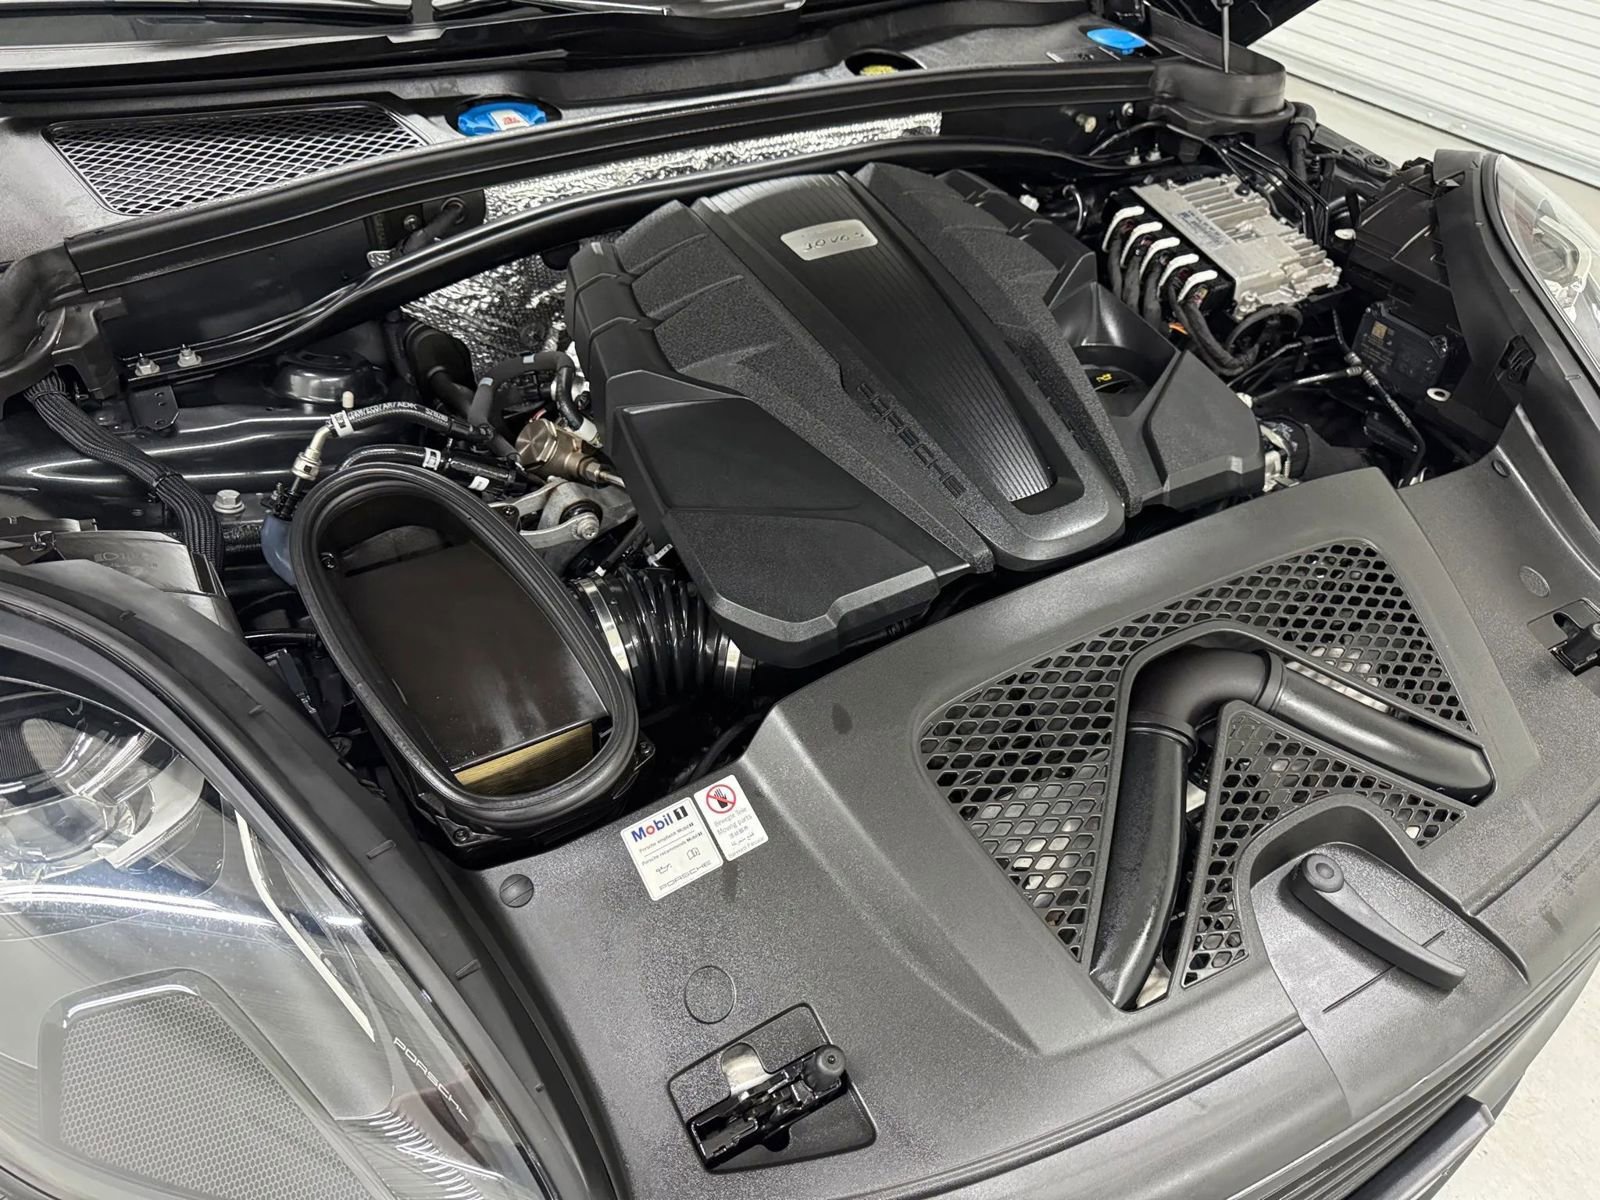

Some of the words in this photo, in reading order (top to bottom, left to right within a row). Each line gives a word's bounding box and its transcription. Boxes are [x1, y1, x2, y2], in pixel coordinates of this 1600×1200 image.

[856, 383, 967, 500] PORSCHE
[631, 813, 674, 842] Mobil
[673, 805, 688, 820] 1
[659, 860, 712, 890] PORSCHE
